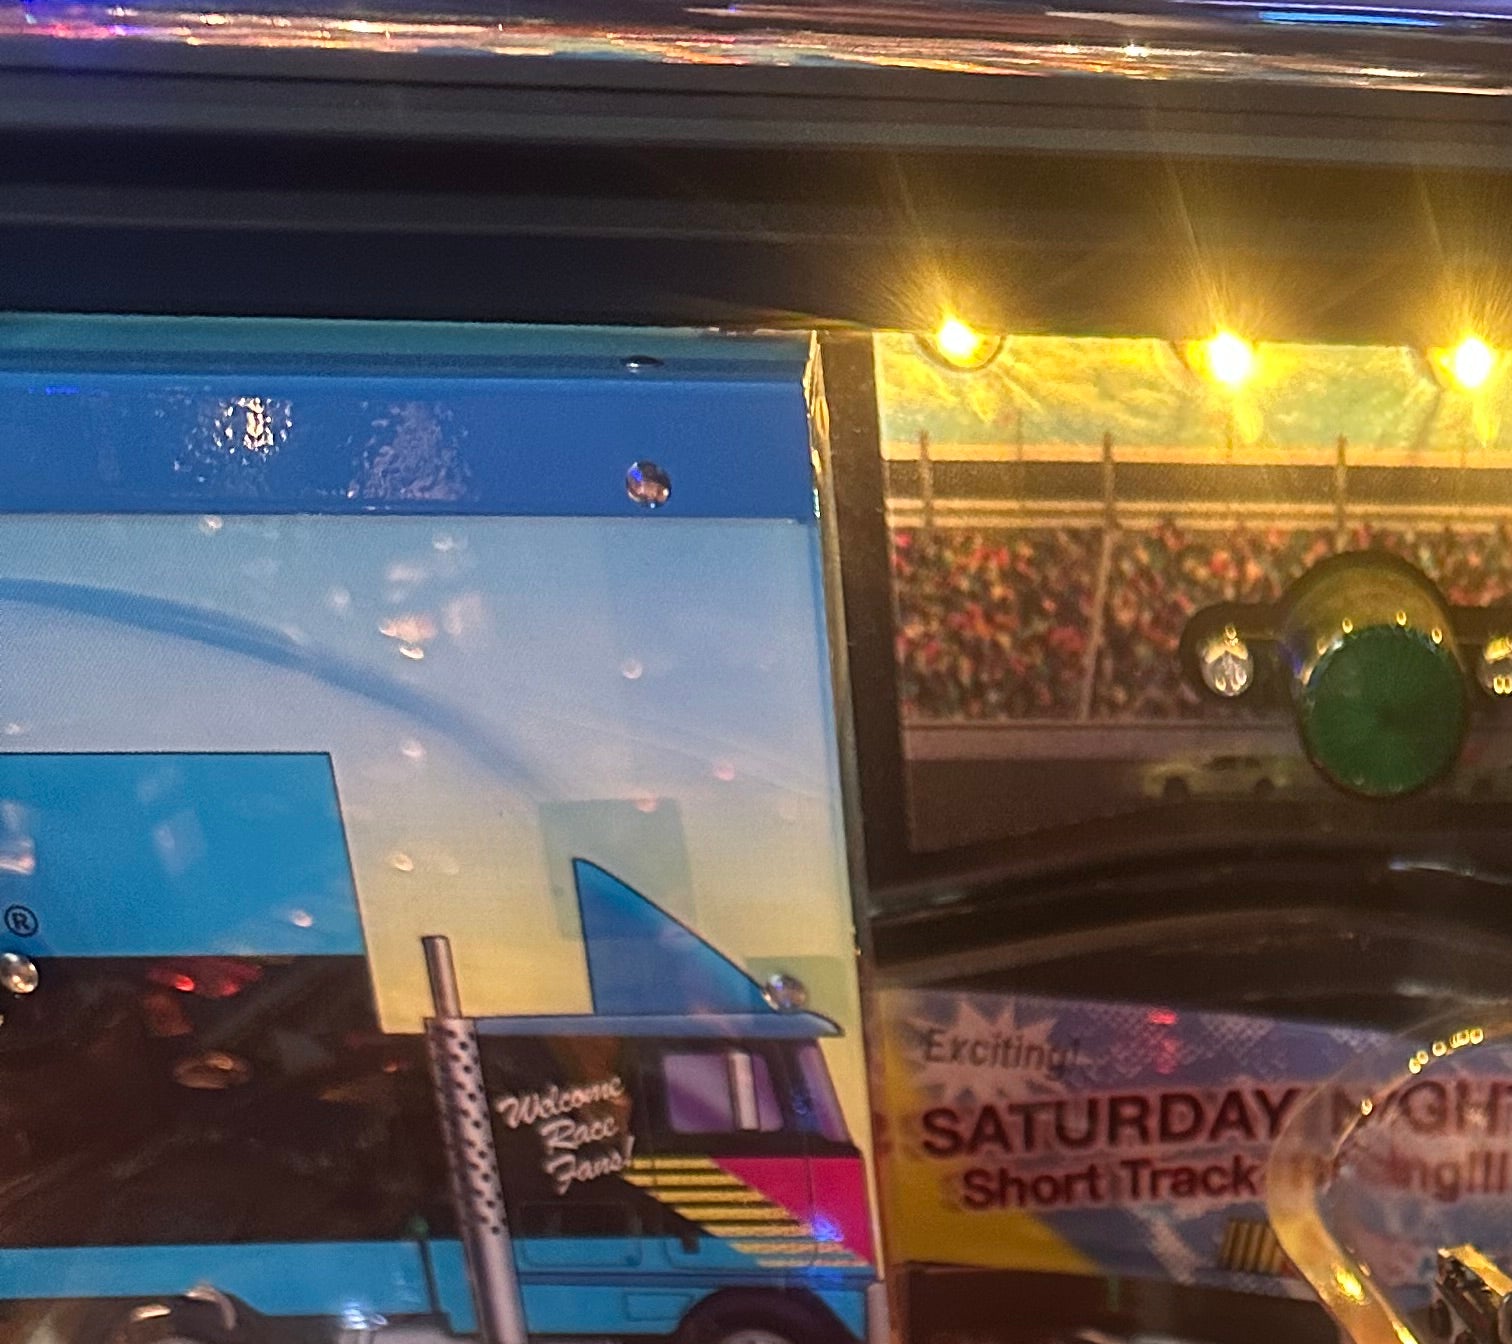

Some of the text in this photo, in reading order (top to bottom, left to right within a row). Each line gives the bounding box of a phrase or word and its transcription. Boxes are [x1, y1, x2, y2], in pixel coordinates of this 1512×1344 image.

[496, 1076, 625, 1129] Welcome
[921, 1086, 1303, 1161] SATURDAY
[540, 1116, 620, 1155] Race
[545, 1135, 636, 1196] Fans!
[960, 1163, 1101, 1210] Short
[1119, 1153, 1262, 1199] Track
